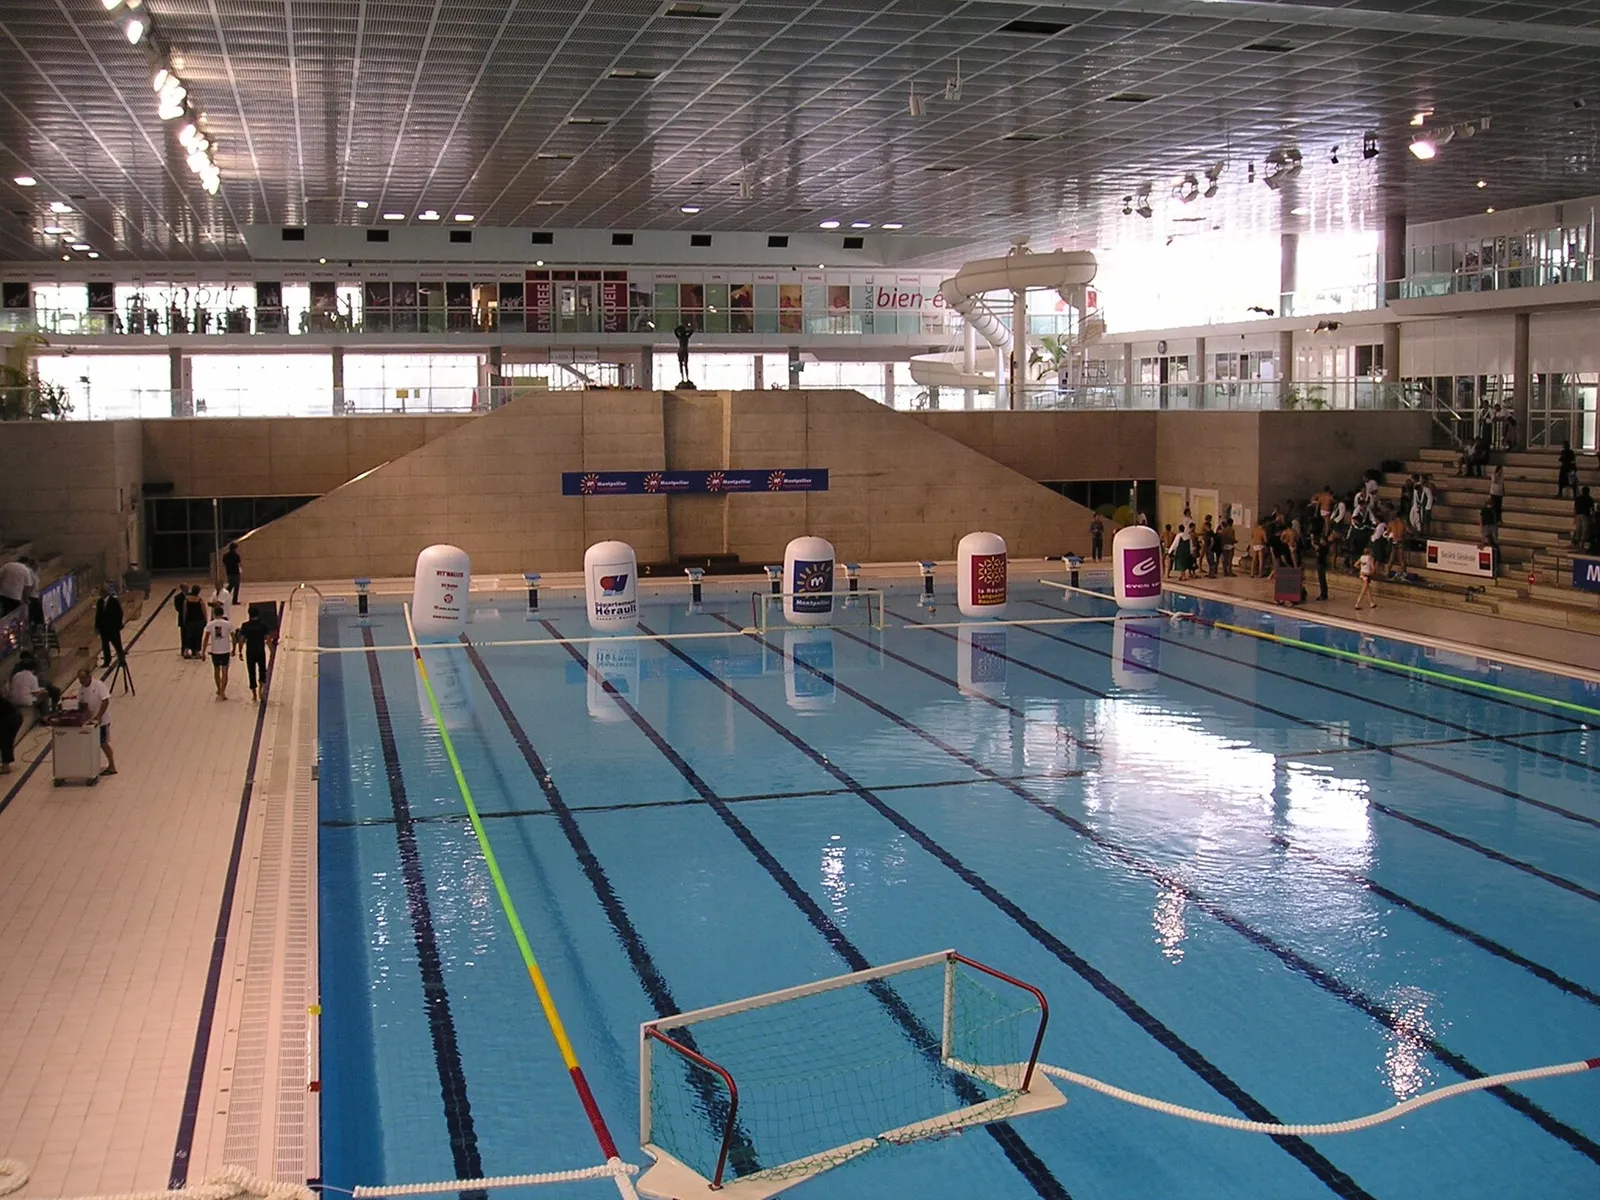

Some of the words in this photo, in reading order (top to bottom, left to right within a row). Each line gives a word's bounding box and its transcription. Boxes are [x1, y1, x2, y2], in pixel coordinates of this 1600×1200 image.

[604, 283, 617, 331] ACCUEIL
[865, 277, 874, 325] ESPACE
[645, 566, 650, 574] 2
[595, 604, 637, 616] Hérault
